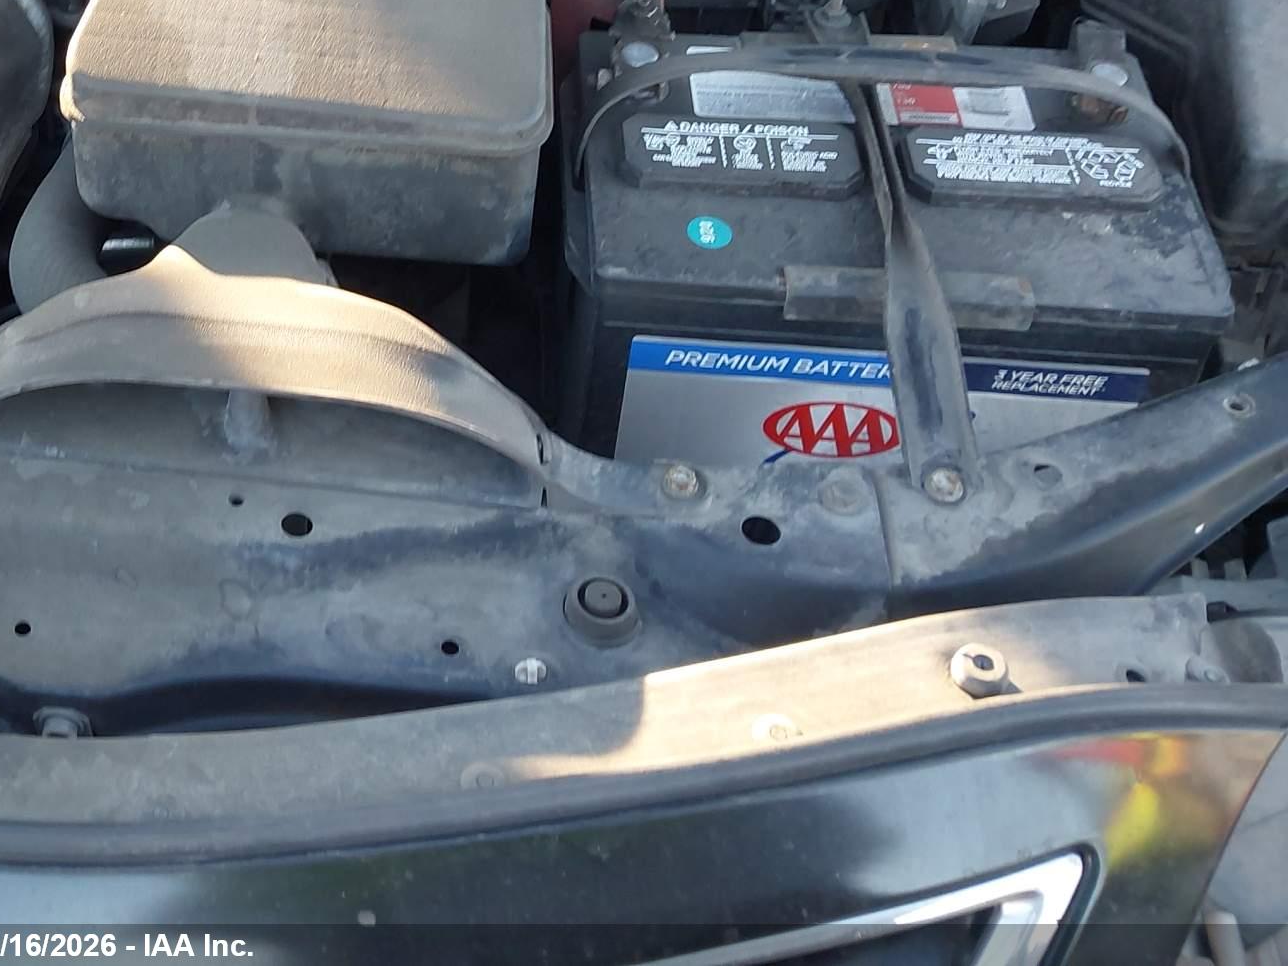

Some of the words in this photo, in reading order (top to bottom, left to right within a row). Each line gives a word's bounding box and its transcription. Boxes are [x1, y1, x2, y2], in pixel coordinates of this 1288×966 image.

[679, 121, 740, 135] DANGER
[754, 124, 810, 137] POISON
[665, 350, 790, 372] PREMIUM
[1011, 371, 1058, 384] YEAR
[1059, 374, 1108, 387] FREE
[991, 380, 1100, 396] REPLACEMENT
[770, 403, 896, 458] AAA
